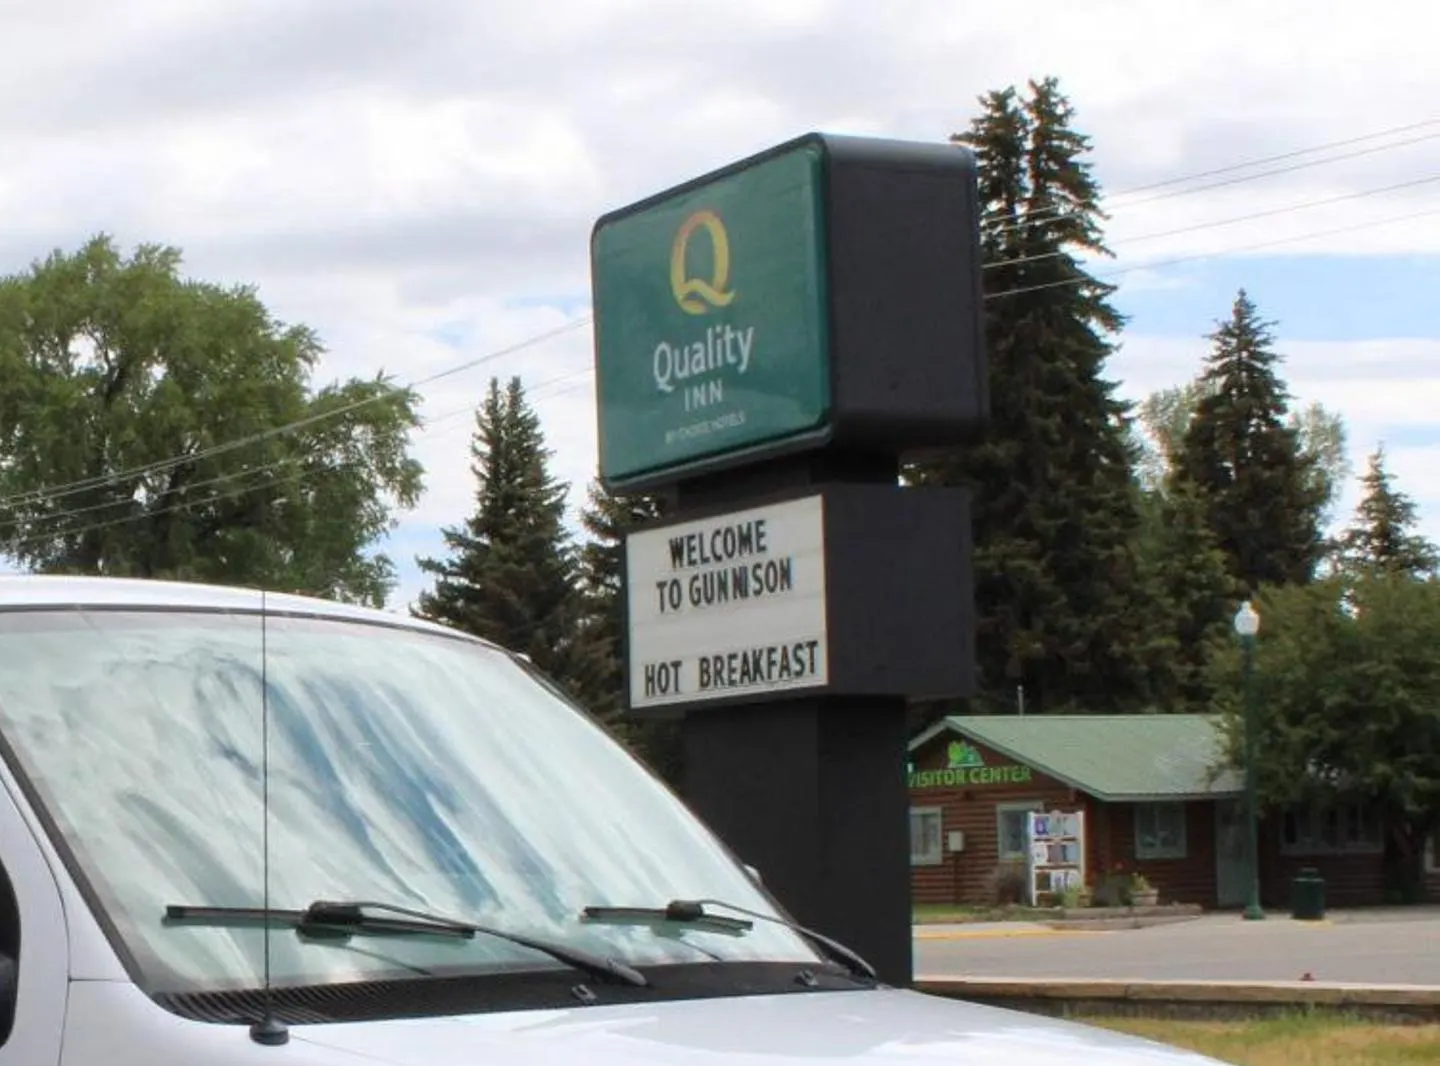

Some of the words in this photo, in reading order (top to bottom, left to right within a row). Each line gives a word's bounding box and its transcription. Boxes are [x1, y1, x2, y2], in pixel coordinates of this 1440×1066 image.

[670, 210, 736, 315] Q
[653, 324, 754, 392] Quality
[684, 378, 723, 412] INN
[669, 520, 768, 568] WELCOME
[656, 579, 682, 613] TO
[689, 557, 792, 607] GUNNISON
[645, 660, 682, 696] HOT
[698, 641, 819, 689] BREAKFAST
[969, 765, 1032, 784] CENTER
